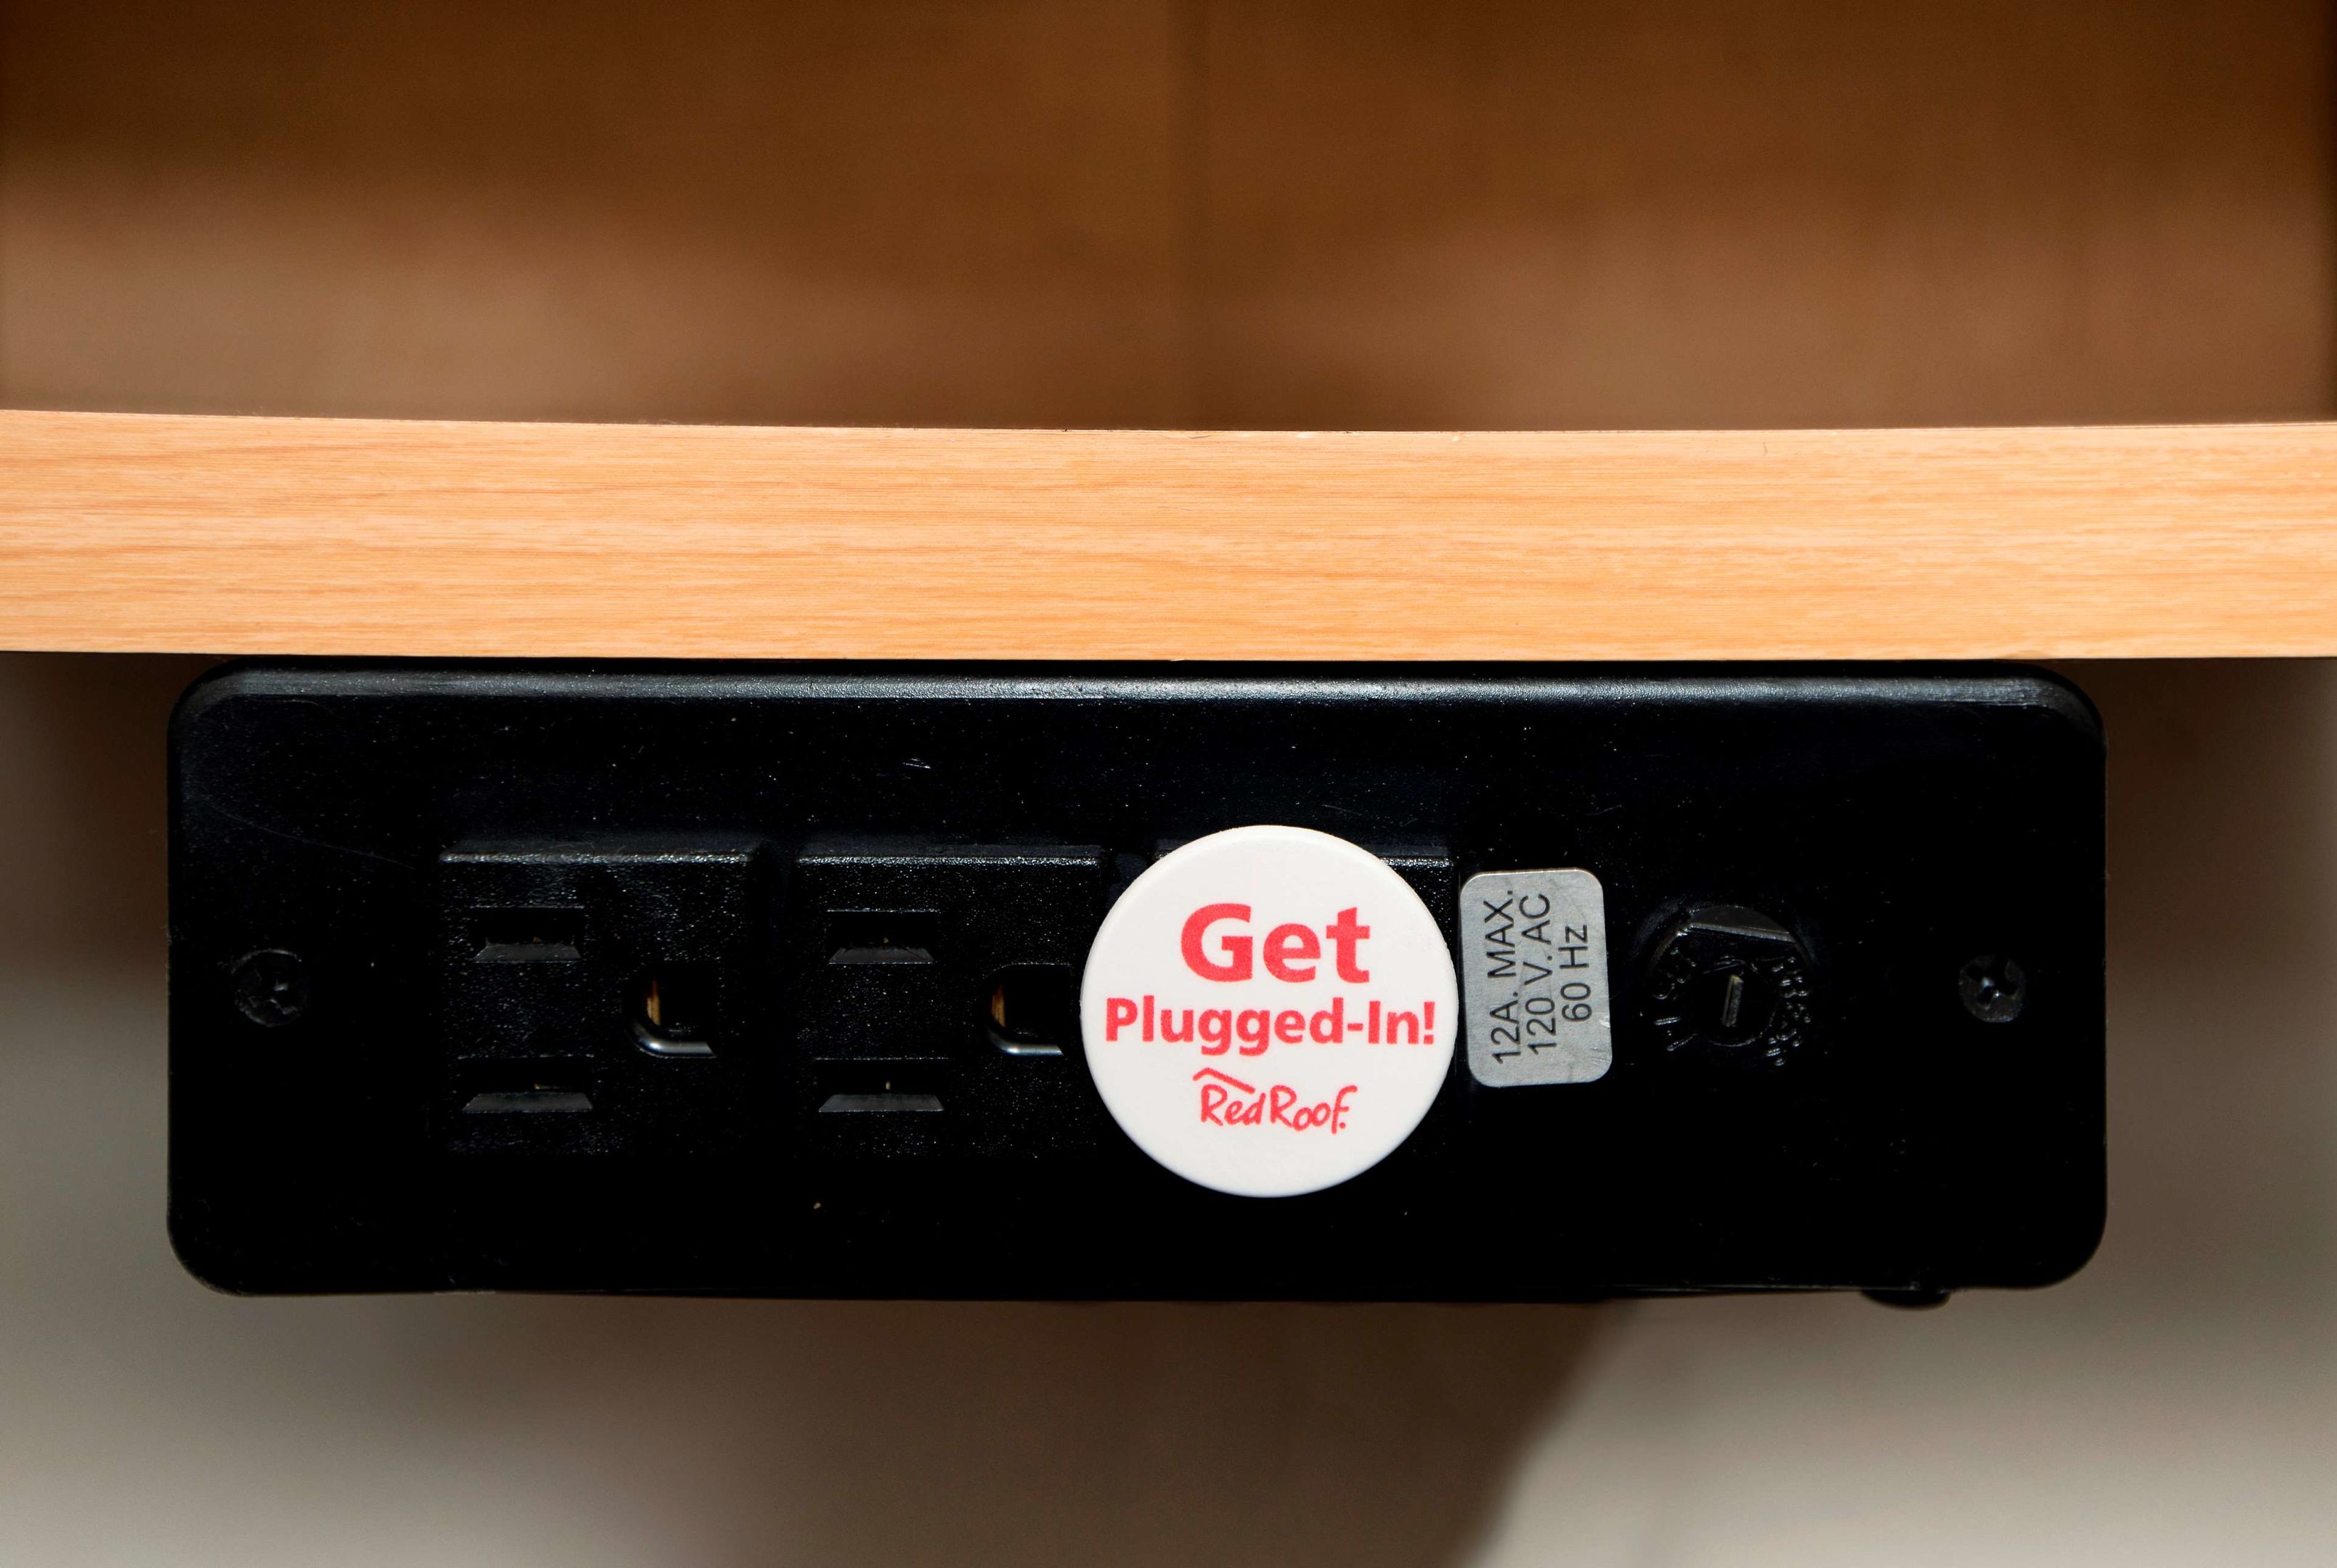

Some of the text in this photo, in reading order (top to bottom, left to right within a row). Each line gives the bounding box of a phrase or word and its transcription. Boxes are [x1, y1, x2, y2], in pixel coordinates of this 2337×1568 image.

[1180, 902, 1371, 984] Get
[1482, 890, 1521, 1064] 12A. MAX.
[1557, 924, 1592, 1022] 60 Hz
[1105, 994, 1436, 1058] Plugged-In!
[1525, 997, 1557, 1055] 120
